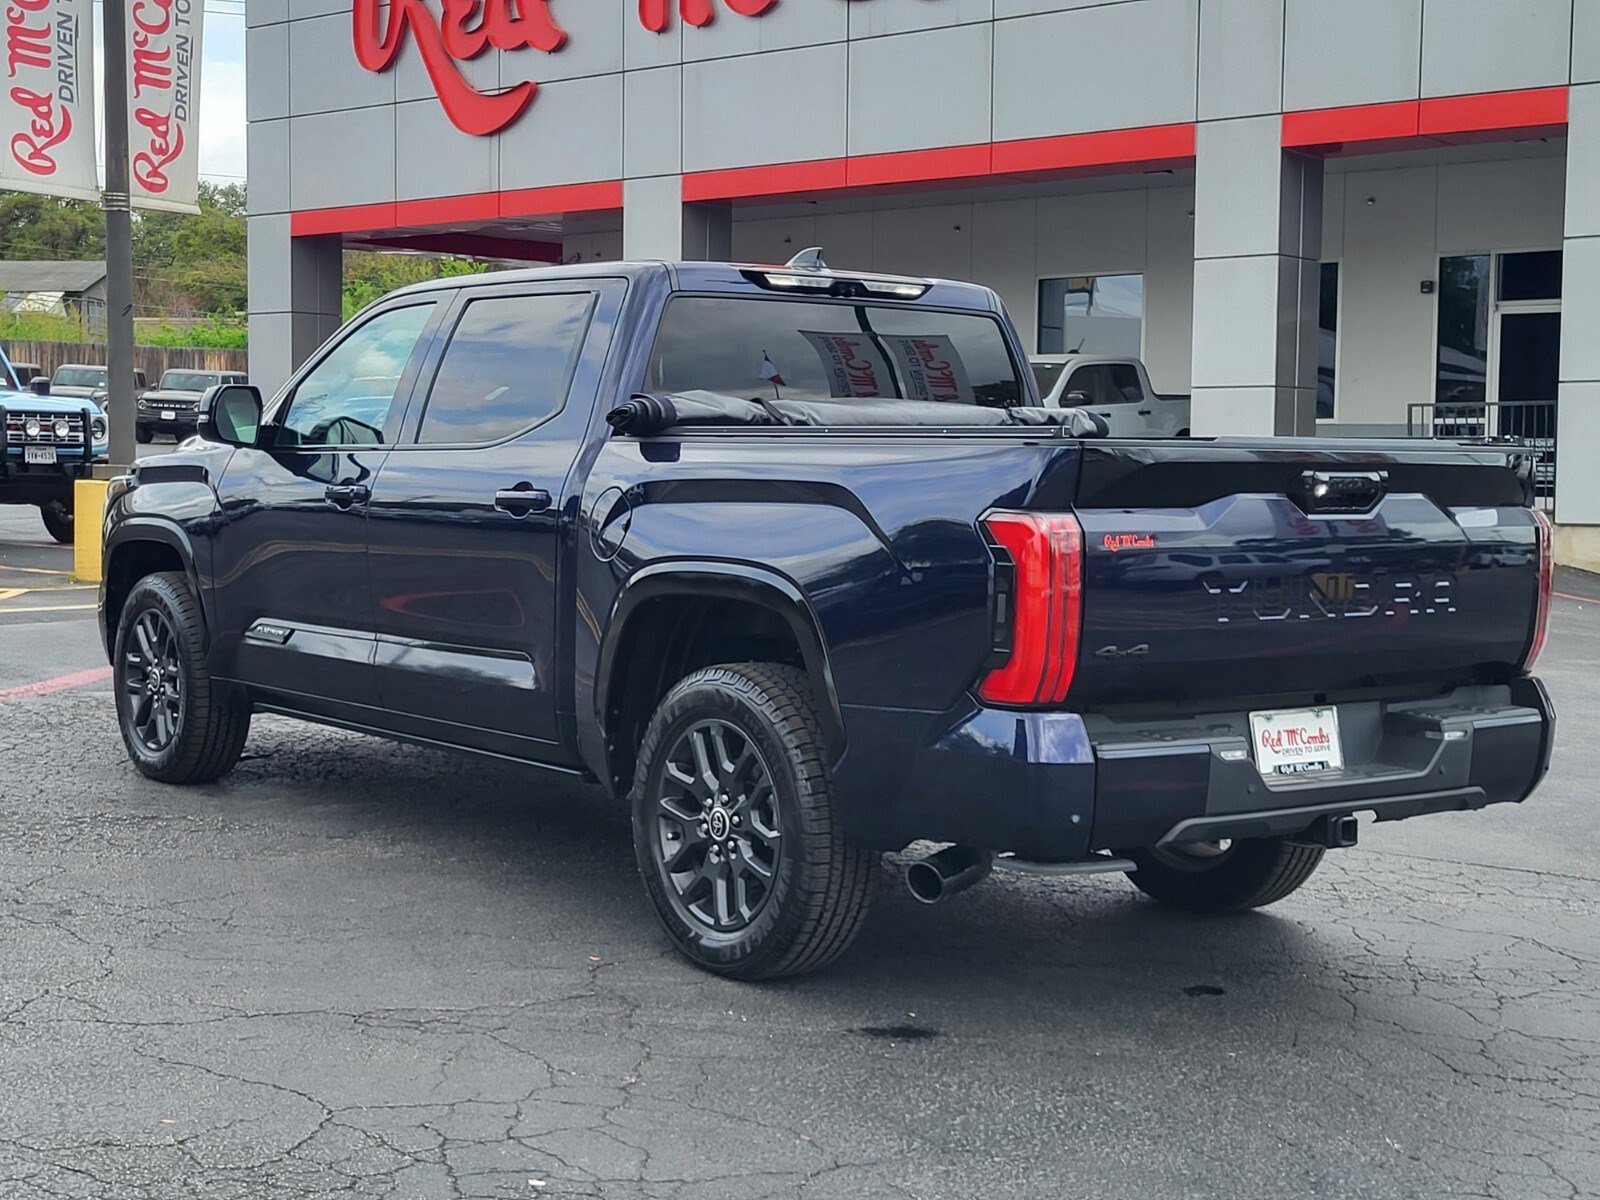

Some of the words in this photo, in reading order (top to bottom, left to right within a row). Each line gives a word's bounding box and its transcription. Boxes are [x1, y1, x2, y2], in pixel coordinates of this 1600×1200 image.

[7, 0, 52, 78] Mc
[175, 0, 191, 26] TO
[56, 11, 75, 104] DRIVEN
[174, 34, 191, 122] DRIVEN
[10, 86, 73, 176] Red
[132, 107, 185, 193] Red
[1104, 534, 1120, 552] Red
[1261, 729, 1283, 754] Red
[1283, 726, 1330, 746] McCombs
[1282, 748, 1303, 756] DRIVEN
